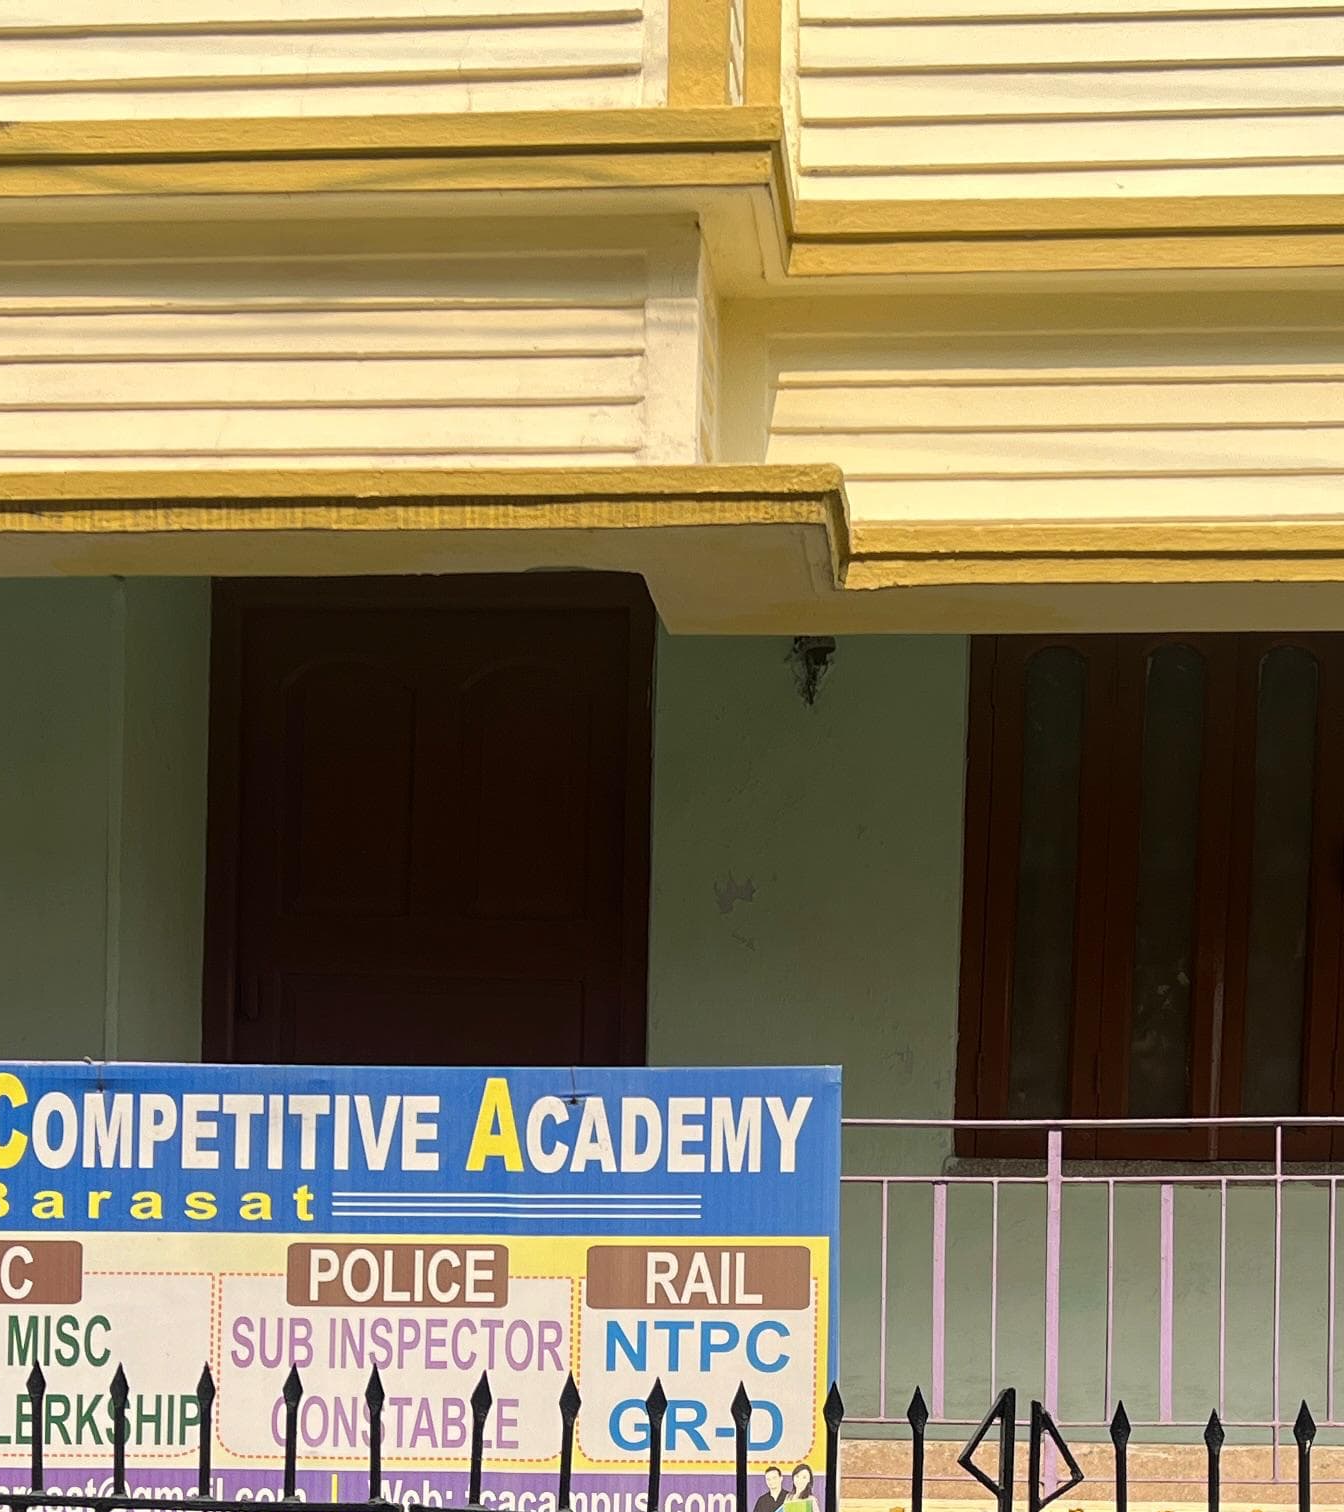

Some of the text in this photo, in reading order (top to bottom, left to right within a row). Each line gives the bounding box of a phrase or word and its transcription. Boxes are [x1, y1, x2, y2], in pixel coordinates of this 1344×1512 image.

[465, 1077, 813, 1174] ACADEMY
[308, 1248, 495, 1304] POLICE
[645, 1252, 763, 1305] RAIL
[7, 1314, 112, 1367] MISC
[231, 1316, 564, 1371] SUB INSPECTOR
[606, 1320, 791, 1373] NTPC
[271, 1395, 520, 1449] CONSTABE
[609, 1398, 784, 1452] GR-D
